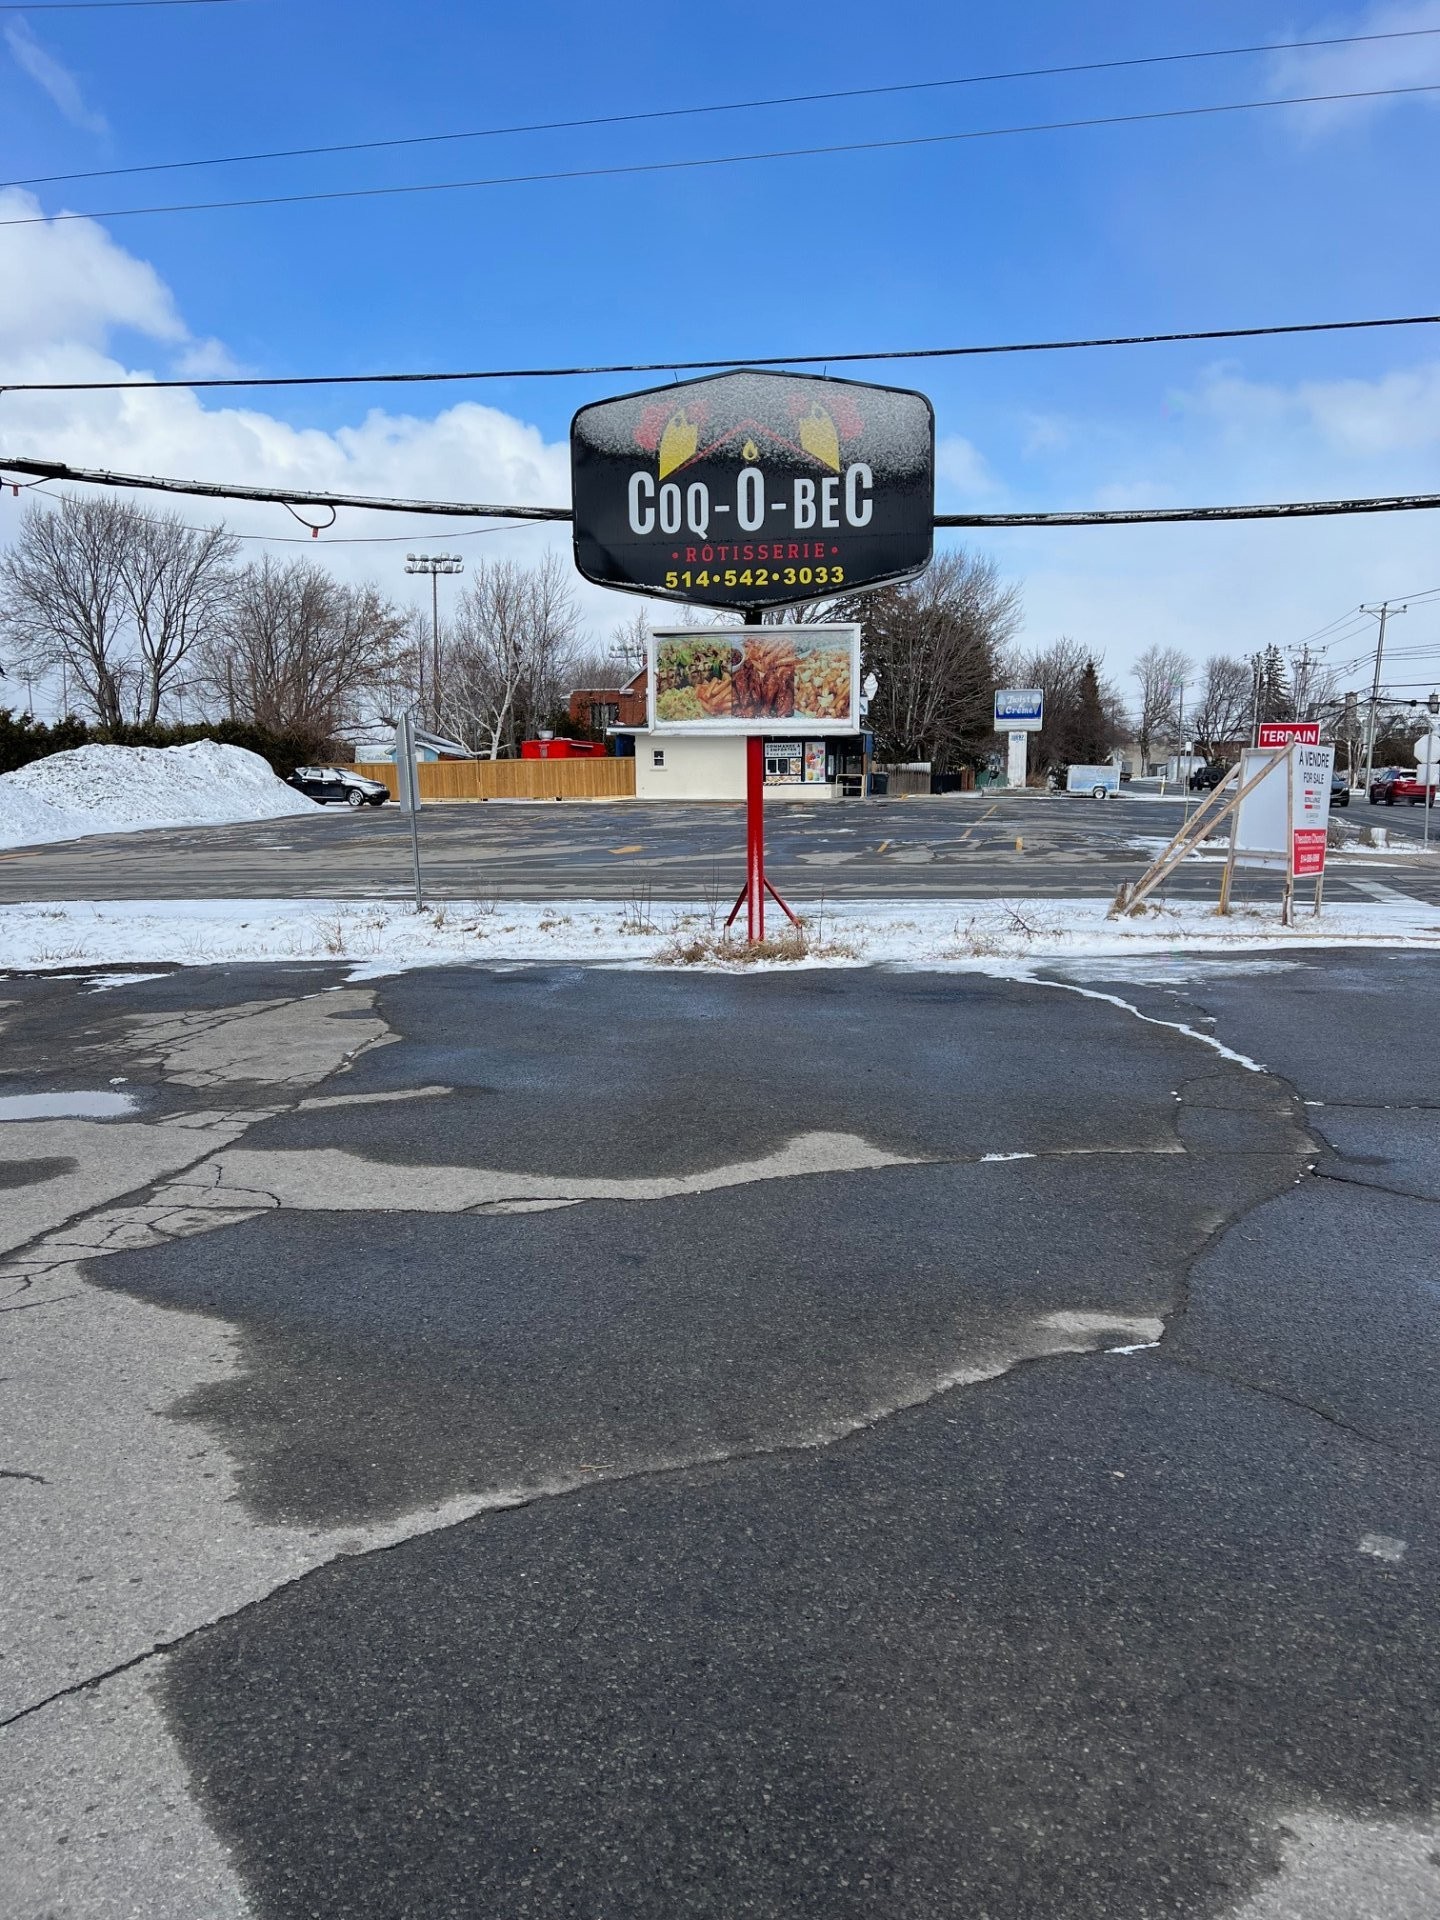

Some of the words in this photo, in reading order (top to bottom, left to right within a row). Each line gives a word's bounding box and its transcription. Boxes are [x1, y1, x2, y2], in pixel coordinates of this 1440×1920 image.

[685, 543, 825, 562] RÔTISSERIE
[1006, 696, 1030, 704] Twist
[1305, 751, 1330, 768] VENDRE
[1303, 772, 1313, 783] FOR
[1313, 773, 1325, 784] SALE
